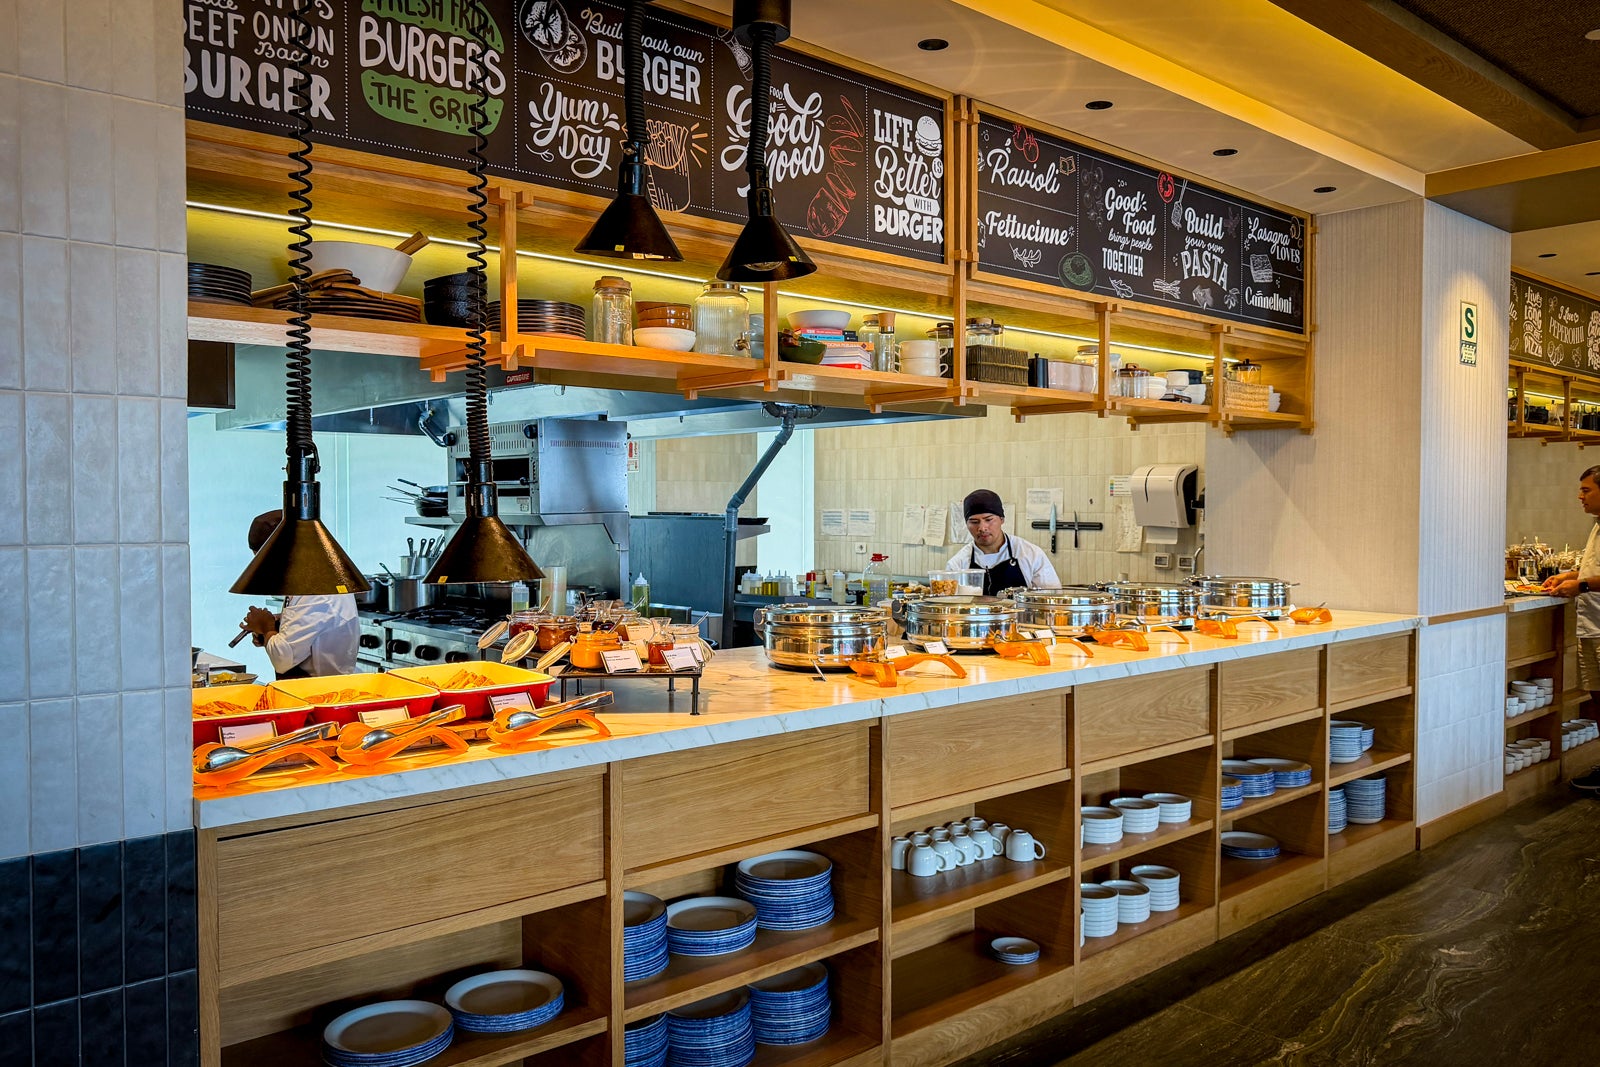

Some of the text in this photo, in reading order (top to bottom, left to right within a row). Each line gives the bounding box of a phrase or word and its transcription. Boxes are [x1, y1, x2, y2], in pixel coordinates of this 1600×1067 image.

[184, 5, 246, 49] EEF
[253, 11, 335, 56] ONION
[254, 41, 329, 68] Bacon
[359, 15, 506, 96] BURGERS
[673, 44, 705, 64] own
[371, 82, 418, 114] THE
[532, 82, 600, 147] Yum
[874, 109, 913, 153] LIFE
[558, 125, 613, 179] Day
[874, 145, 943, 206] Better
[986, 148, 1061, 194] Ravioli
[912, 198, 933, 212] WITH
[1104, 187, 1143, 221] Good
[874, 205, 944, 245] BURGER
[985, 211, 1070, 246] Fettucinne
[1108, 228, 1153, 253] brings people
[1122, 212, 1157, 236] Food
[1184, 207, 1225, 240] Build
[1247, 217, 1291, 255] Lasagna
[1184, 235, 1225, 254] your own
[1276, 245, 1301, 264] LOVES
[1101, 248, 1144, 277] TOGETHER
[1180, 249, 1229, 292] PASTA
[1464, 307, 1474, 339] S
